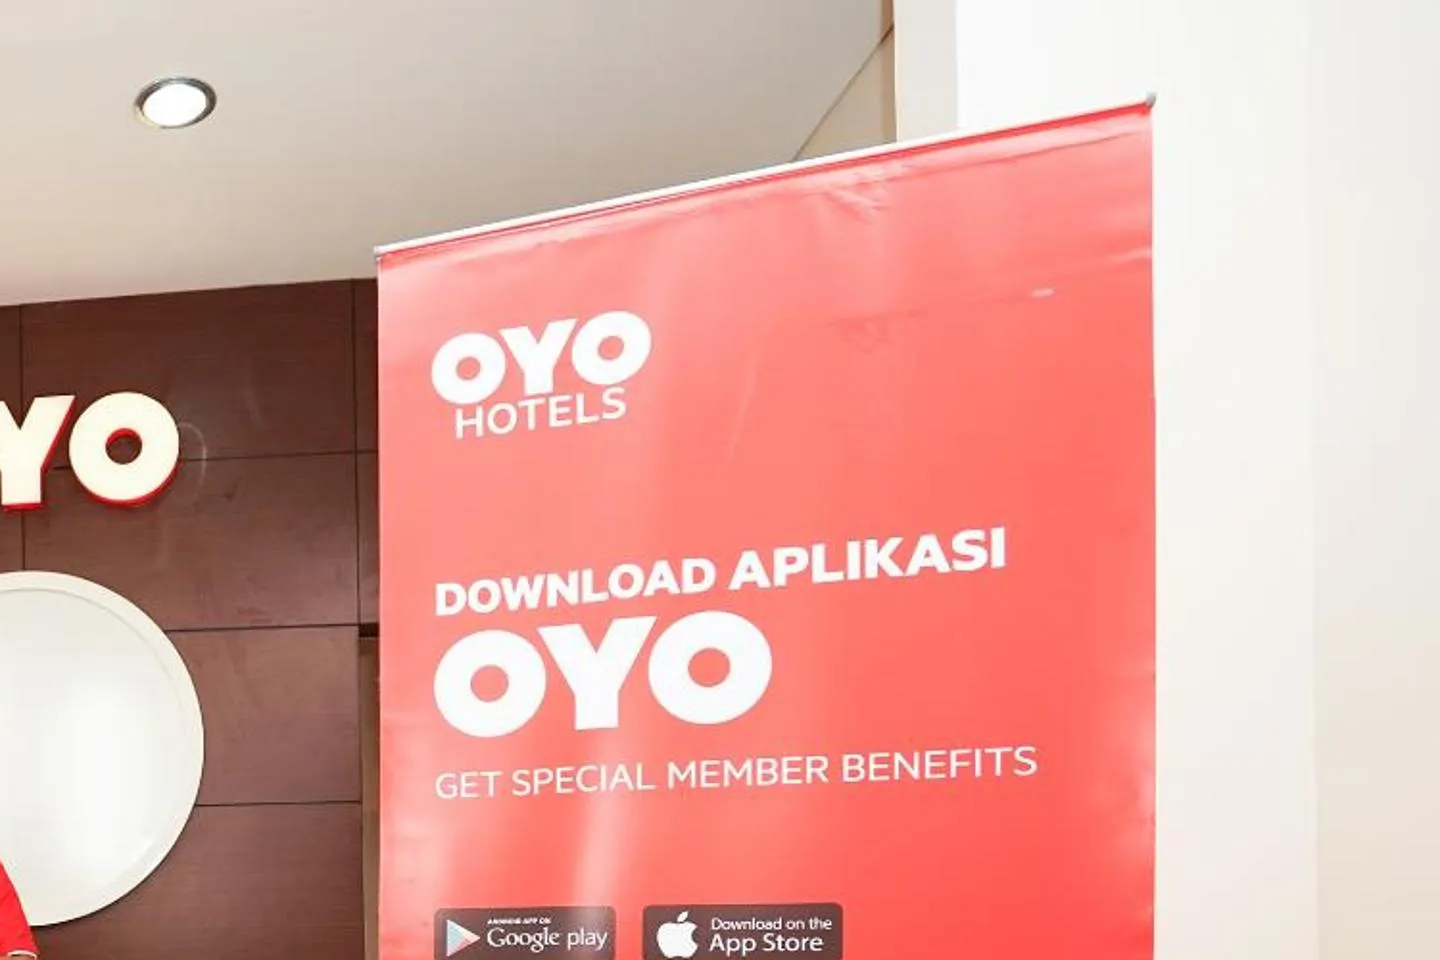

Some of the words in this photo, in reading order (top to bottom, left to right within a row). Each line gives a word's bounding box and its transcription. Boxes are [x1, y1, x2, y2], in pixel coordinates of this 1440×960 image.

[431, 310, 652, 405] OYO
[455, 386, 627, 440] HOTELS
[435, 557, 716, 616] DOWNLOAD
[728, 527, 1006, 591] APLIKASI
[433, 610, 773, 738] OYO
[435, 771, 502, 799] GET
[512, 763, 656, 797] SPECIAL
[667, 756, 829, 789] MEMBER
[842, 746, 1039, 783] BENEFITS
[486, 926, 560, 953] Google
[567, 928, 608, 951] play
[708, 933, 757, 957] App
[762, 932, 825, 951] Store
[711, 917, 782, 930] Download
[785, 920, 805, 930] on
[809, 917, 833, 930] the
